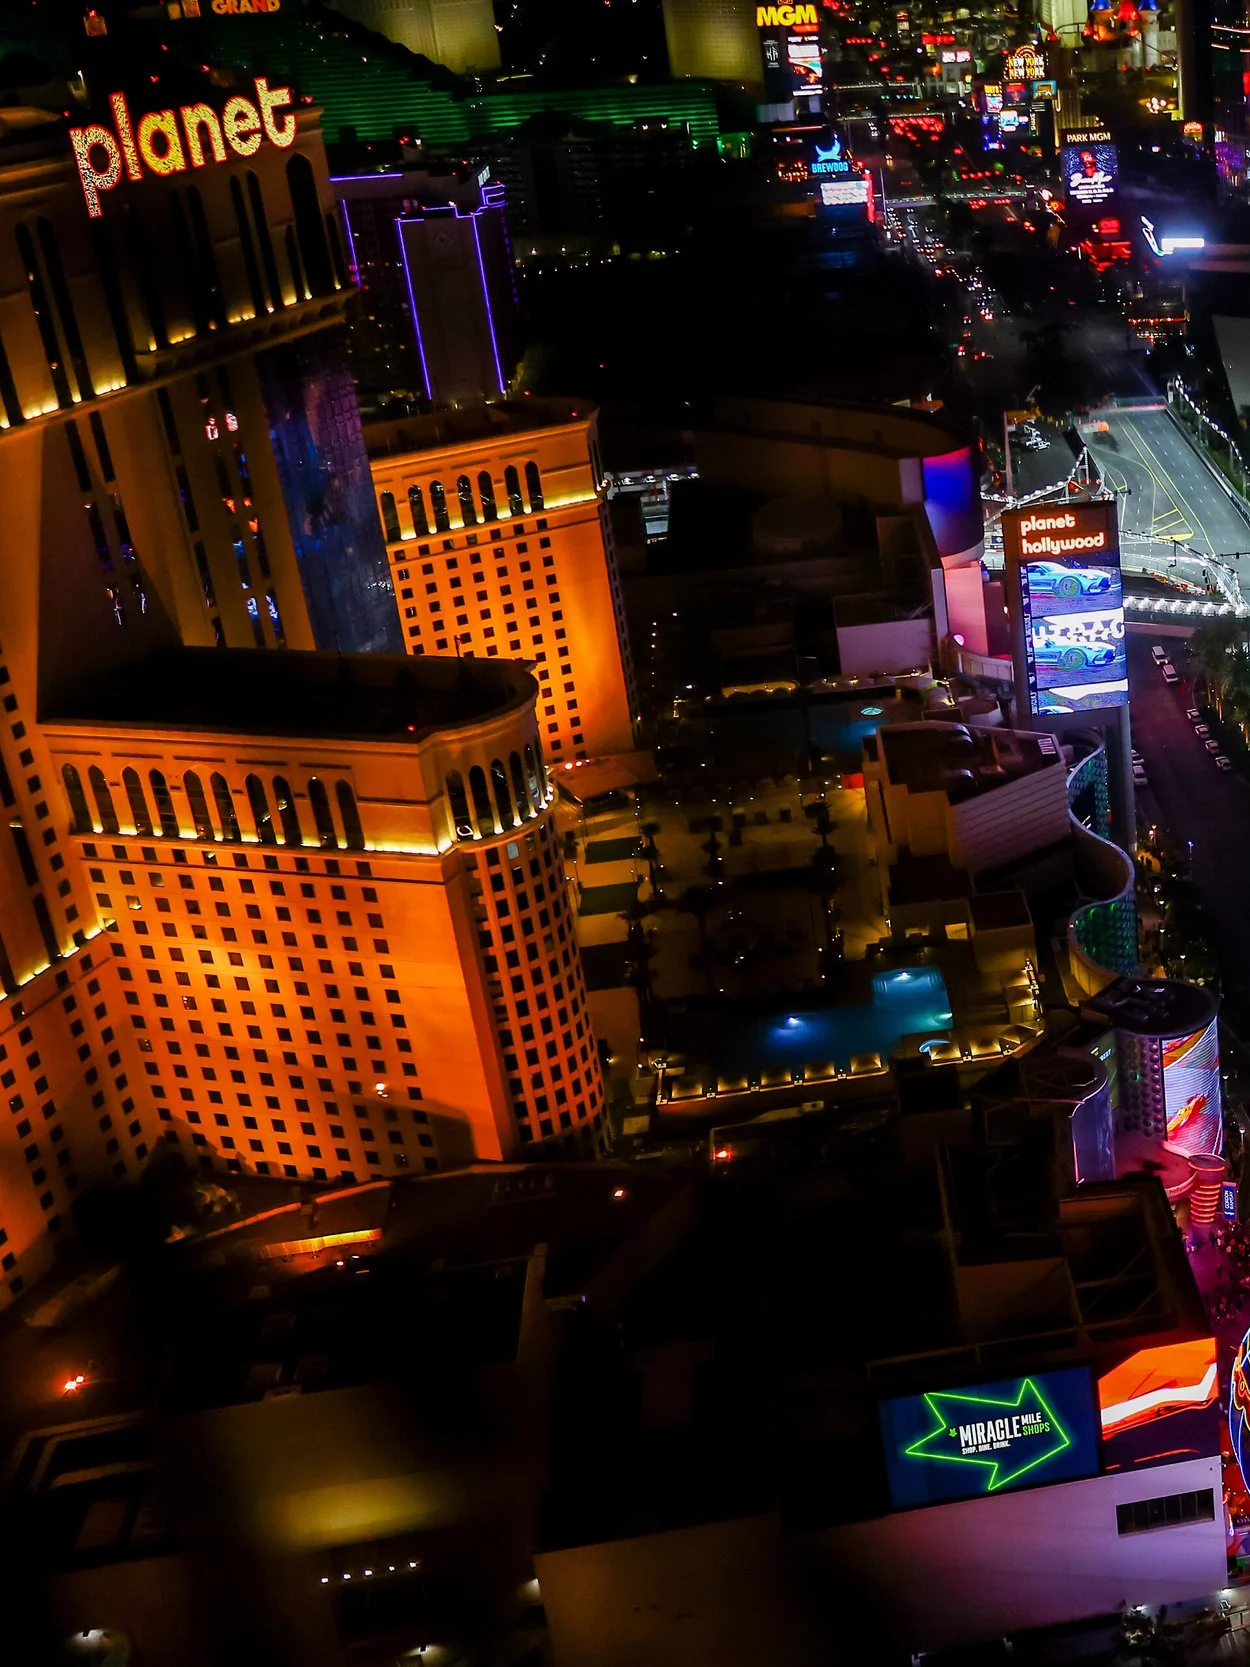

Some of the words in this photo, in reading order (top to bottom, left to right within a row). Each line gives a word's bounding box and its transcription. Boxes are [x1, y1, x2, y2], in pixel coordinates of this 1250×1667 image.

[211, 0, 280, 14] GRAND
[757, 5, 818, 27] MGM
[1008, 56, 1025, 67] NEW
[1025, 55, 1045, 67] YORK
[1008, 67, 1025, 77] NEW
[1025, 66, 1045, 77] YORK
[1066, 133, 1089, 142] PARK
[1089, 132, 1111, 141] MGM
[69, 77, 297, 218] planet
[811, 162, 849, 173] BREWDOG
[1020, 513, 1076, 536] planet
[1022, 532, 1104, 555] hollywood
[1021, 1412, 1042, 1425] MILE
[959, 1415, 1022, 1448] MIRACLE
[1022, 1421, 1050, 1436] SHOPS
[961, 1446, 978, 1455] SHOP.
